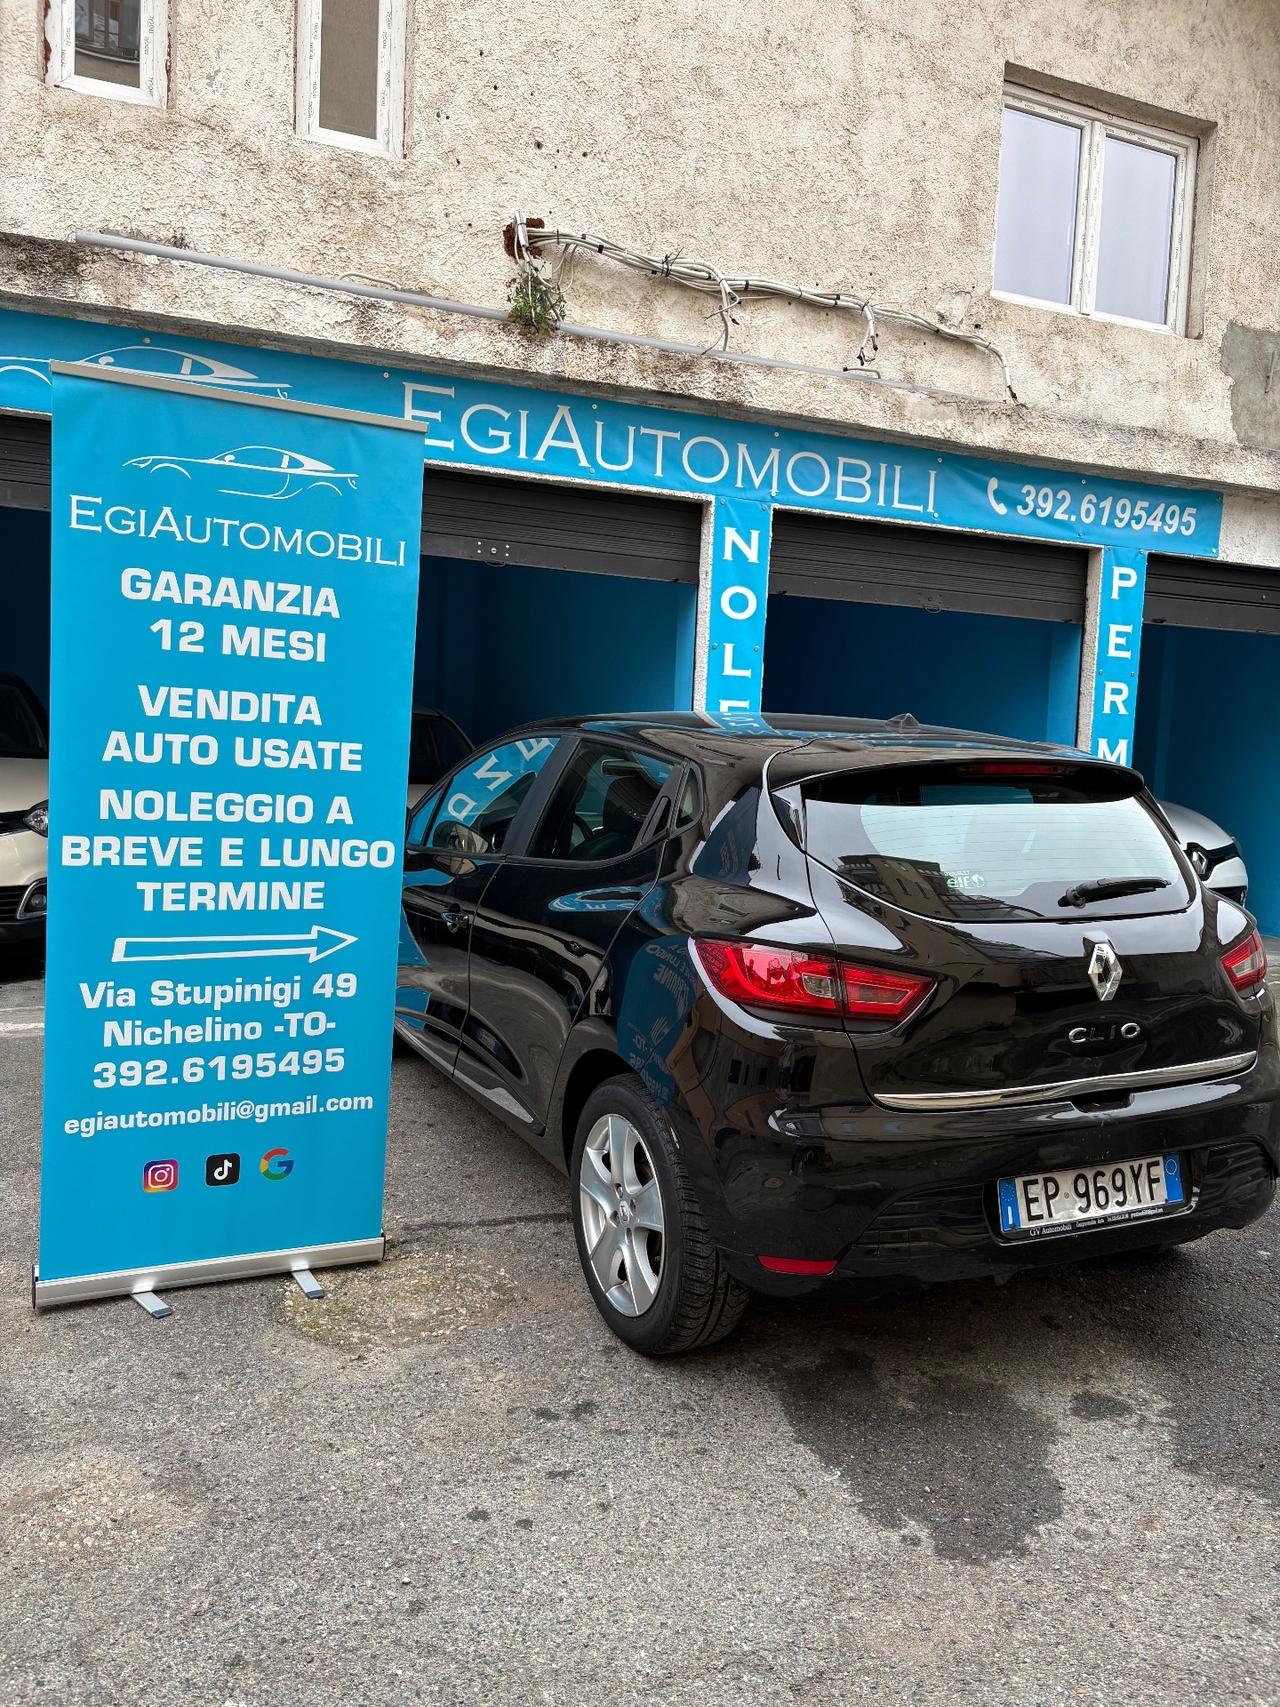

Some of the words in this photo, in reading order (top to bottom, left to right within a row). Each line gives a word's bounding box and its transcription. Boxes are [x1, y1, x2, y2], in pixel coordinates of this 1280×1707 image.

[1015, 484, 1197, 537] 392.6195495
[121, 567, 340, 619] GARANZIA
[150, 618, 205, 653] 12
[222, 624, 326, 663] MESI
[1097, 566, 1139, 767] PERM
[138, 684, 322, 726] VENDITA
[101, 731, 219, 766] AUTO
[234, 736, 363, 772] USATE
[99, 789, 314, 824] NOLEGGIO
[325, 796, 354, 825] A
[61, 835, 203, 867] BREVE
[220, 837, 244, 867] E
[260, 837, 395, 869] LUNGO
[136, 881, 325, 912] TERMINE
[79, 980, 136, 1010] Via
[150, 974, 301, 1011] Stupinigi
[312, 972, 357, 999] 49
[103, 1012, 263, 1048] Nichelino
[274, 1010, 336, 1038] -TO-
[1068, 1022, 1141, 1044] CLIO
[93, 1048, 345, 1088] 392.6195495
[64, 1094, 374, 1137] egiautomobili@gmail.com
[1022, 1176, 1060, 1222] EP
[1073, 1159, 1161, 1214] 969YF
